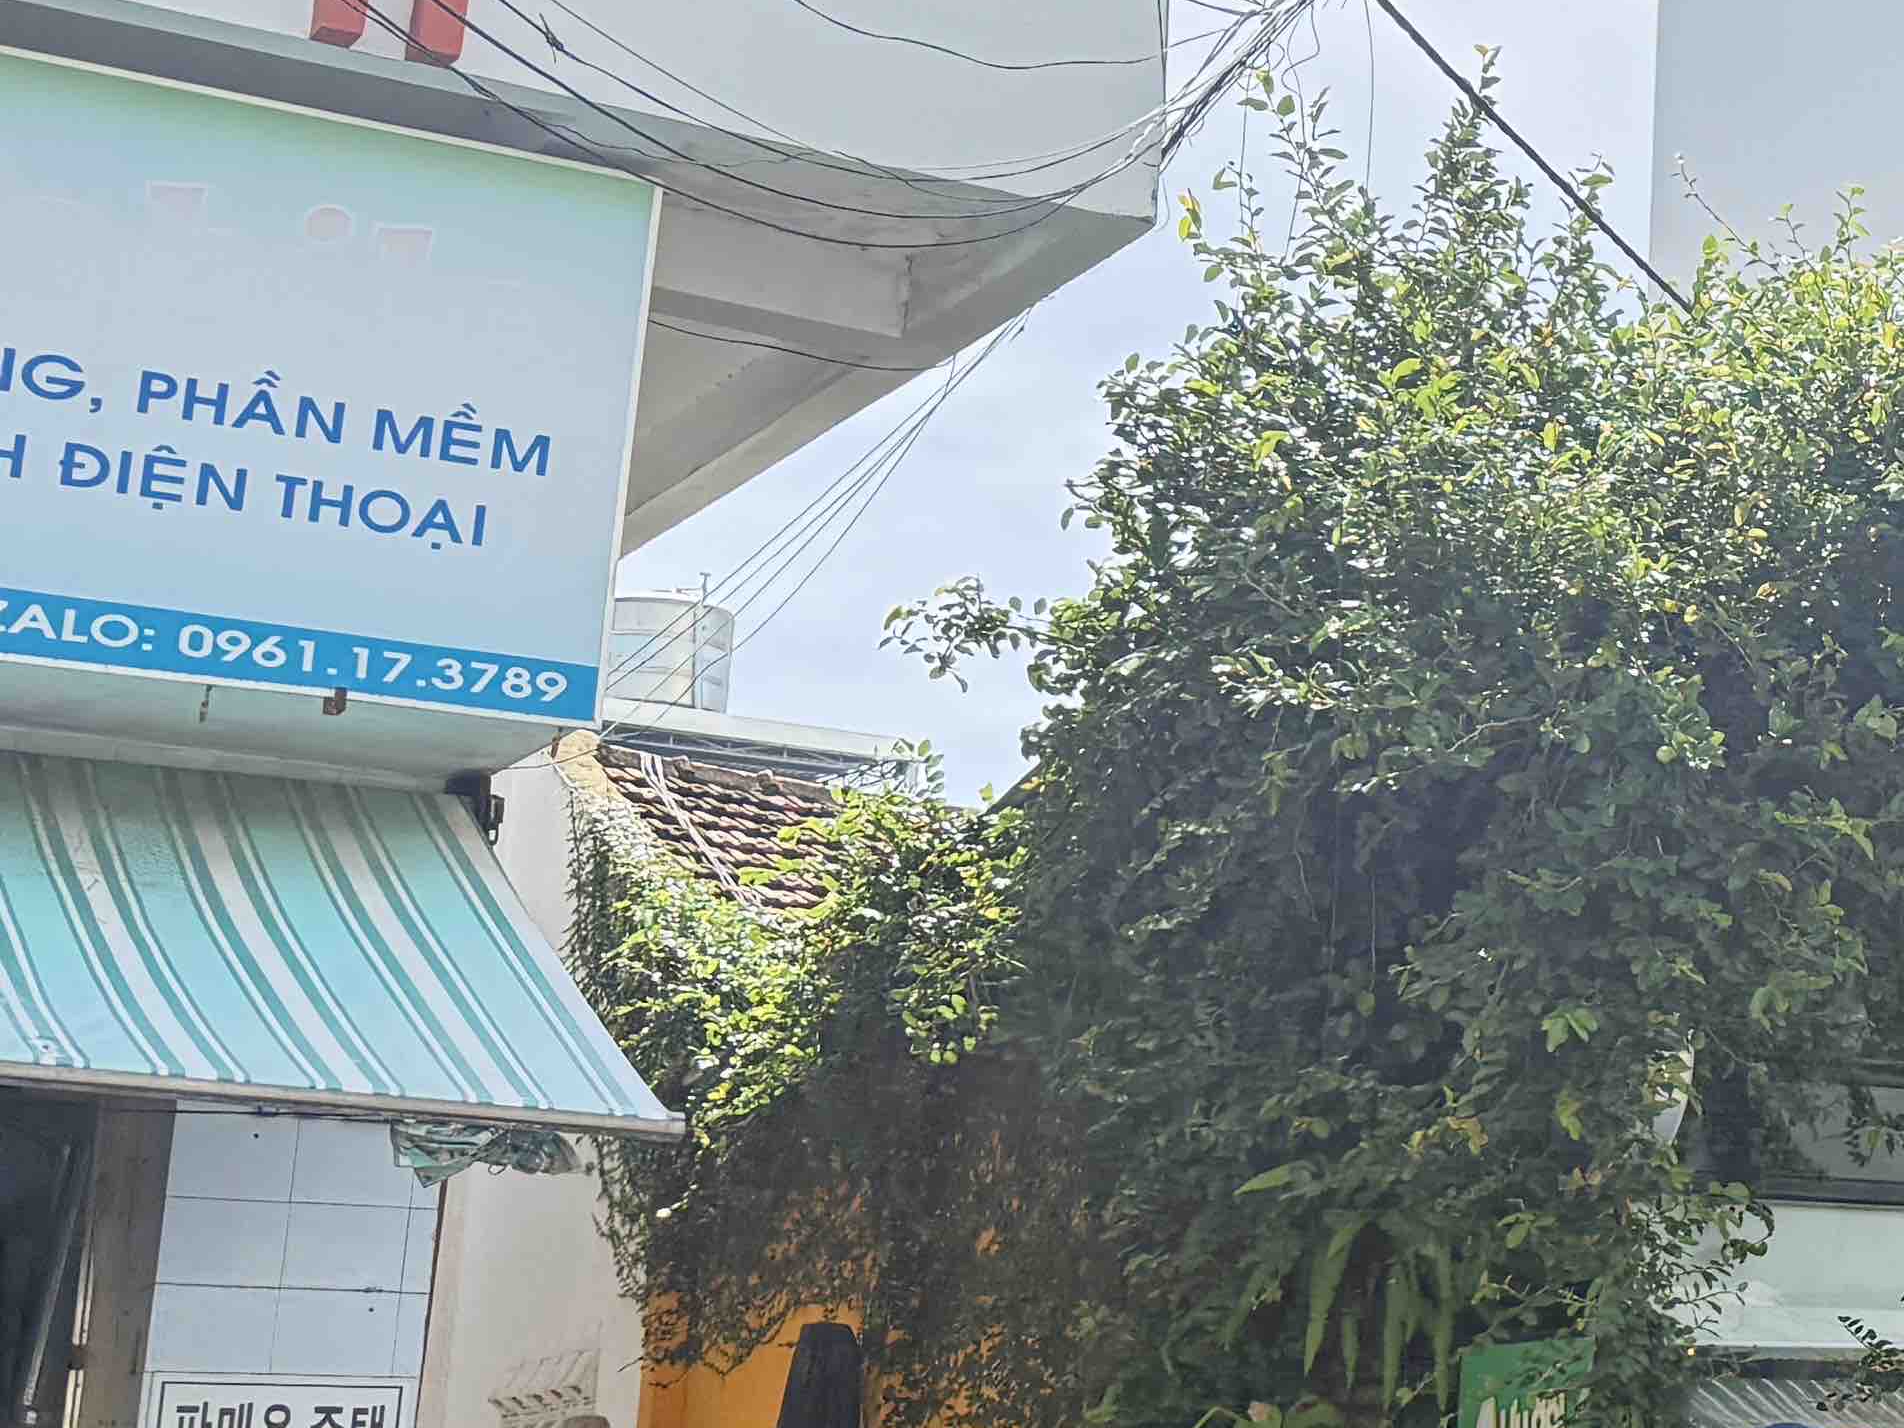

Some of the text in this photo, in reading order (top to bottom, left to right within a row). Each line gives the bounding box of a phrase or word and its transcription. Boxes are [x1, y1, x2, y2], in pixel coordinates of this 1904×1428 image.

[136, 369, 347, 443] PHẦN
[371, 402, 551, 476] MỀM
[58, 442, 248, 512] ĐIỆN
[274, 472, 487, 550] THOẠI
[0, 600, 568, 702] ALO: 0961.17.3789
